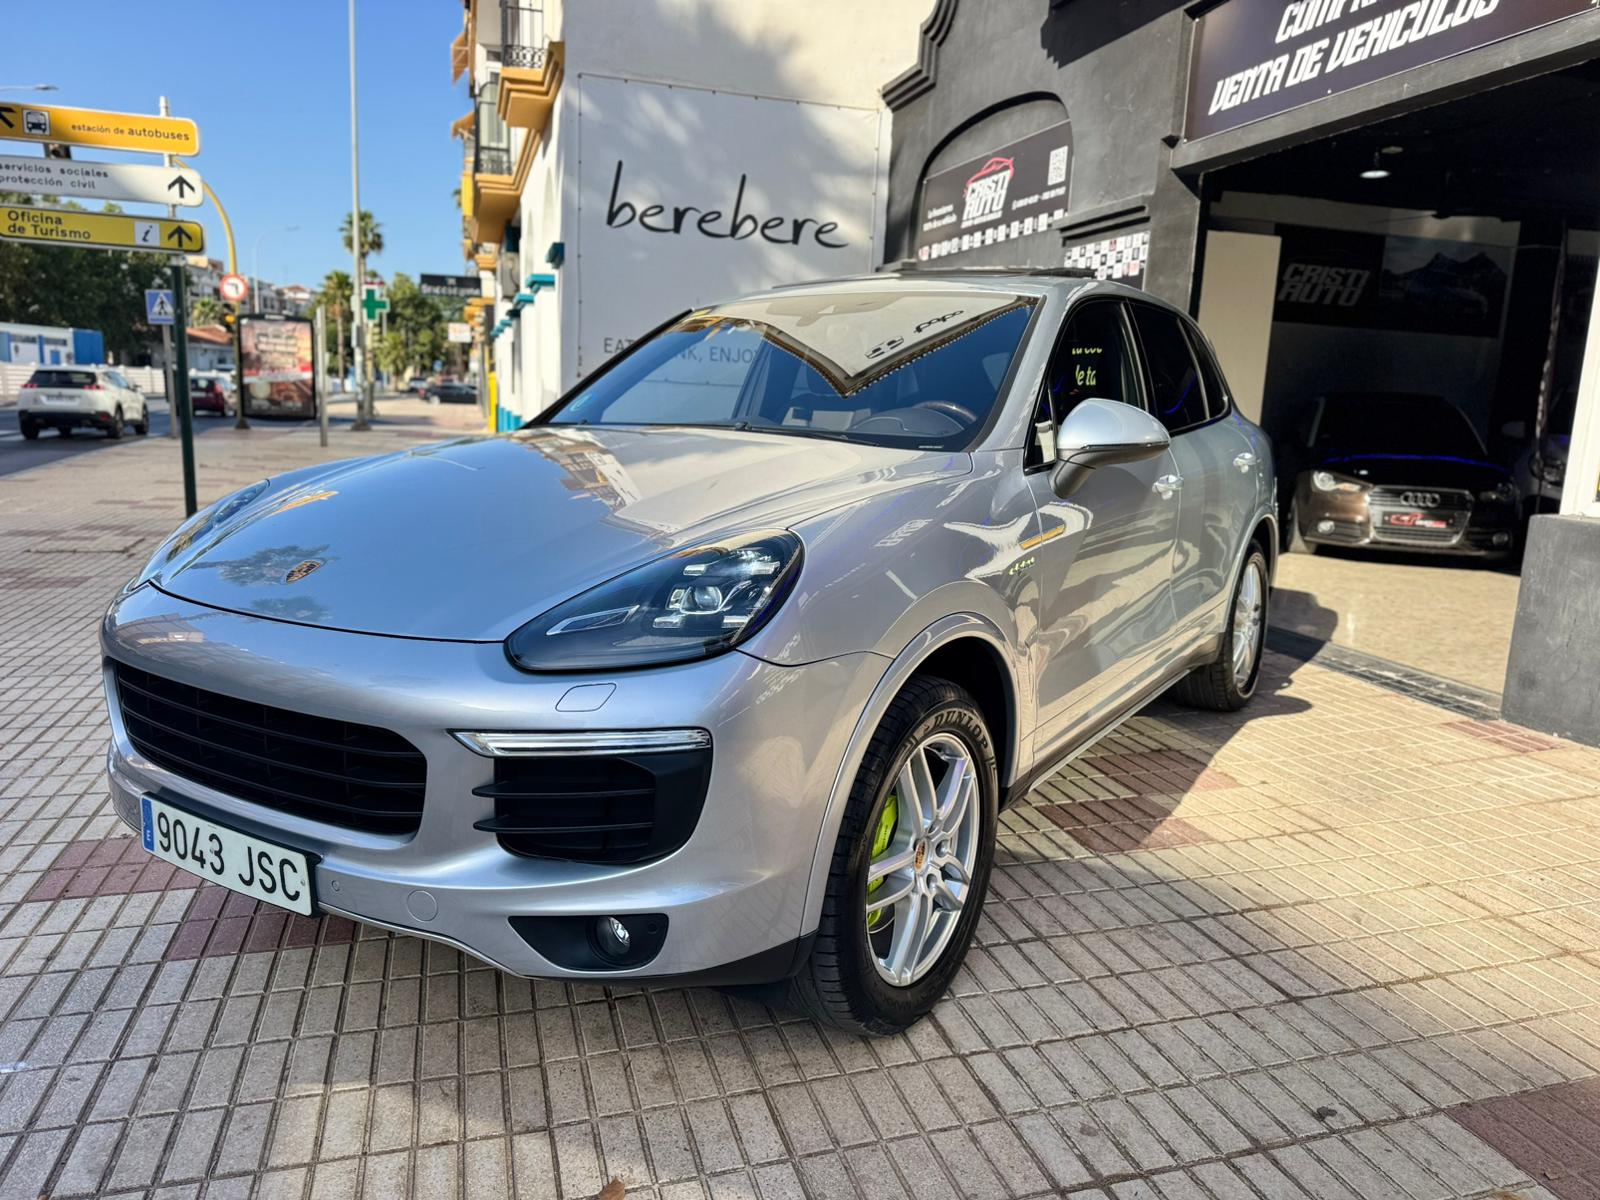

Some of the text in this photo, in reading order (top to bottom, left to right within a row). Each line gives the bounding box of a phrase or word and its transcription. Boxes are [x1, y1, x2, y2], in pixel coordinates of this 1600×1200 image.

[1208, 0, 1500, 116] VENTA DE VEHICULOS
[71, 123, 190, 141] estación de autobuses
[60, 167, 109, 178] sociales
[70, 179, 96, 189] civil
[606, 160, 849, 248] berebere
[962, 190, 1007, 221] AUTO
[8, 210, 63, 225] Oficina
[8, 222, 91, 240] de Turismo
[1282, 263, 1370, 288] CRISTI
[1278, 281, 1362, 307] AUTO
[933, 709, 988, 749] DUNLOP
[157, 811, 225, 875] 9043
[238, 846, 300, 902] JSC
